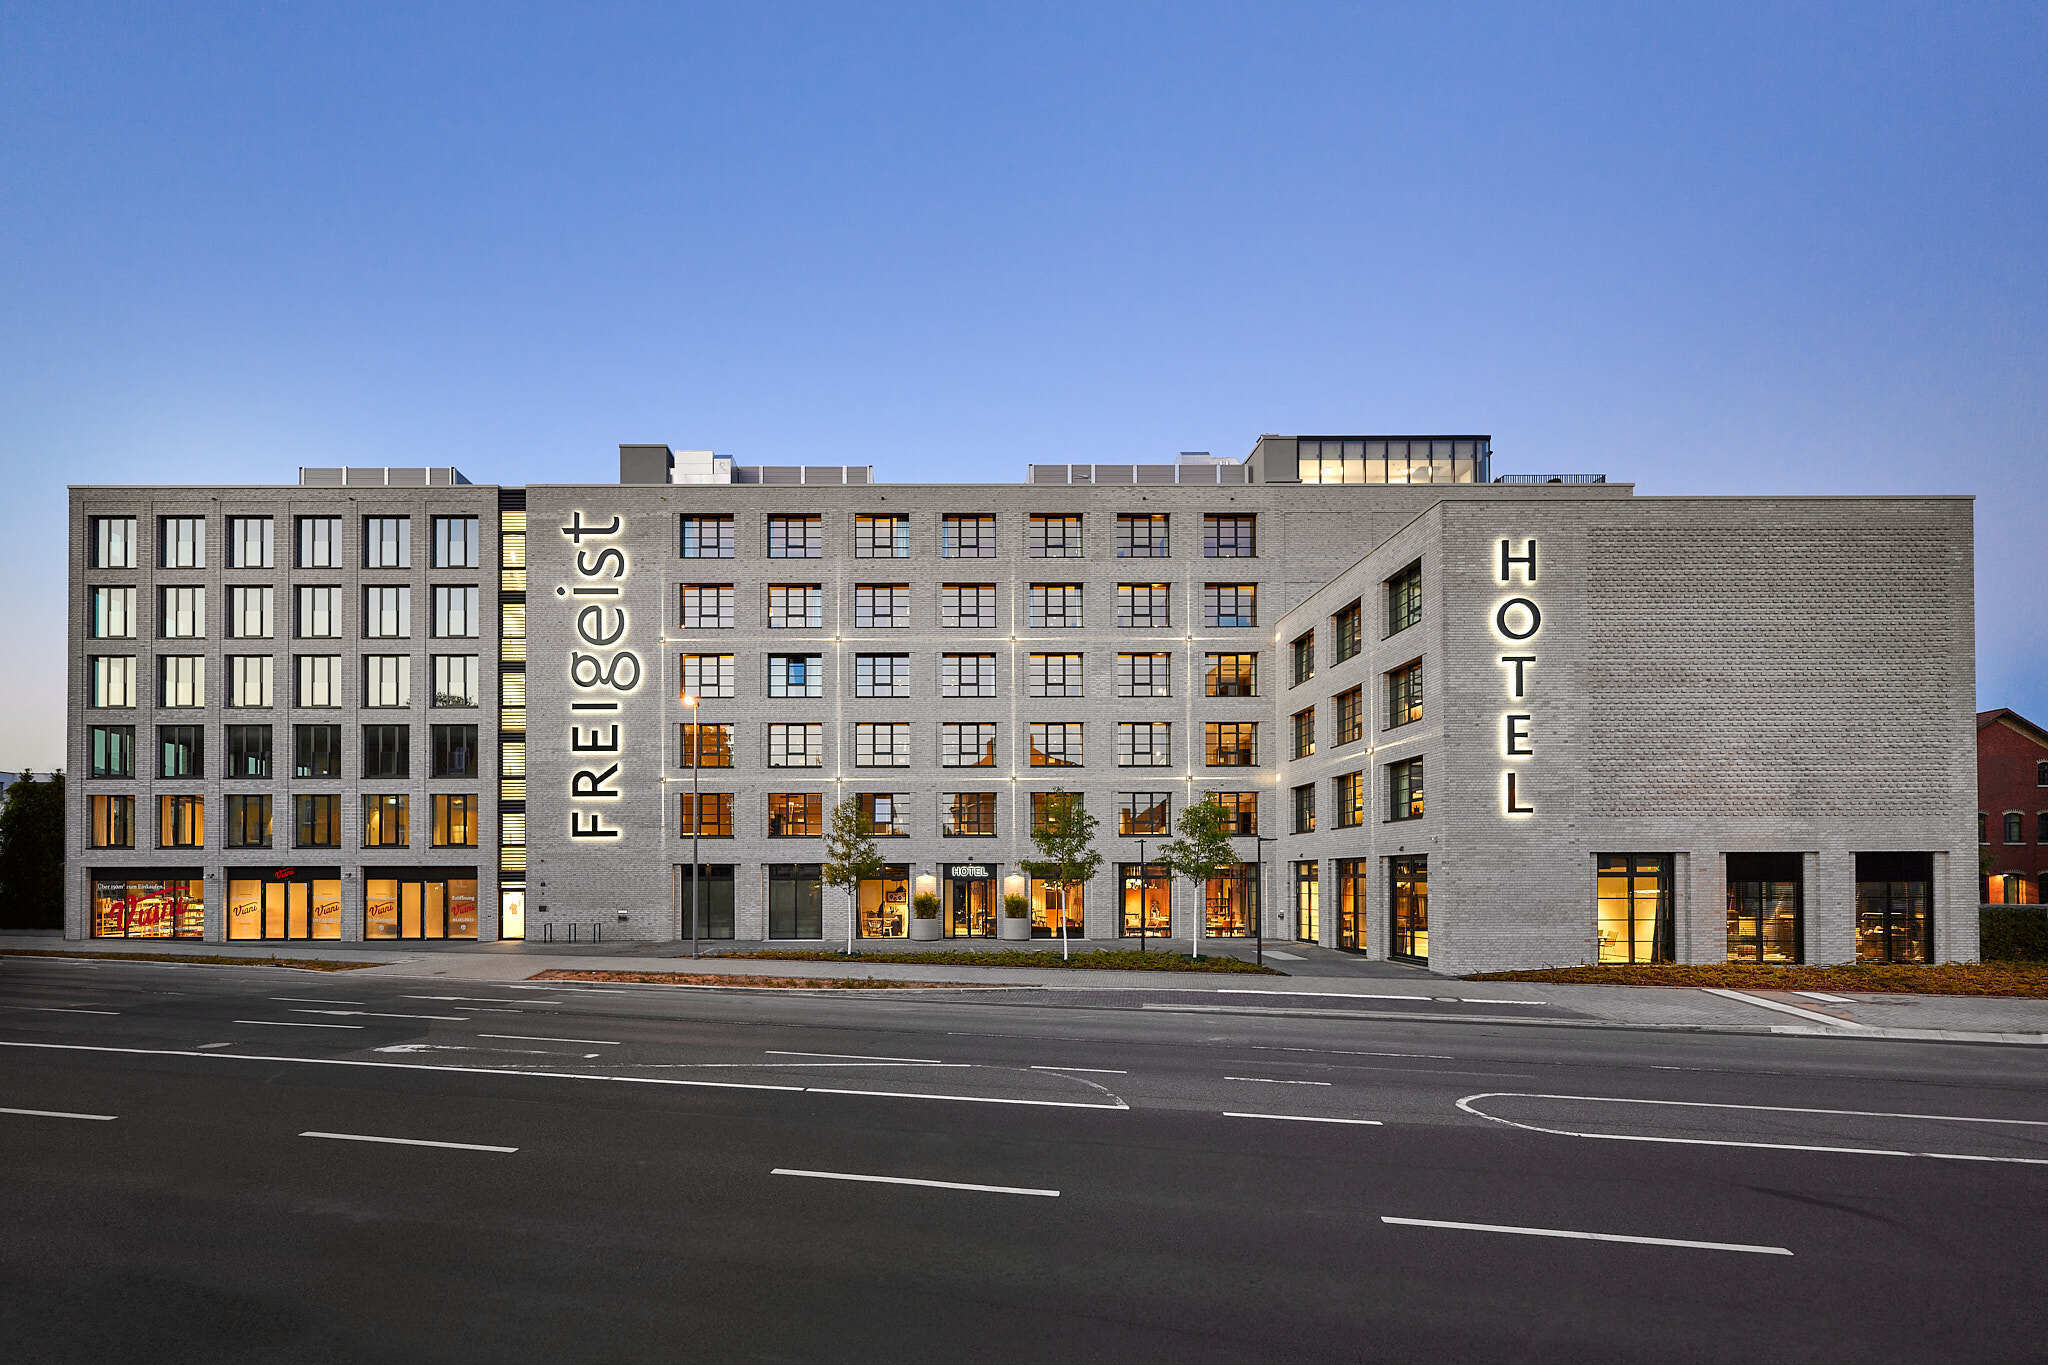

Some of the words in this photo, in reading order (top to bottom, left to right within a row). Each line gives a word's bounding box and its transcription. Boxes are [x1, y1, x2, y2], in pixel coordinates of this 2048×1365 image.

[556, 511, 640, 837] FREIgeist
[1496, 539, 1541, 813] HOTEL
[952, 866, 988, 877] HOTEL
[232, 901, 258, 917] Viani
[314, 901, 340, 917] Viani
